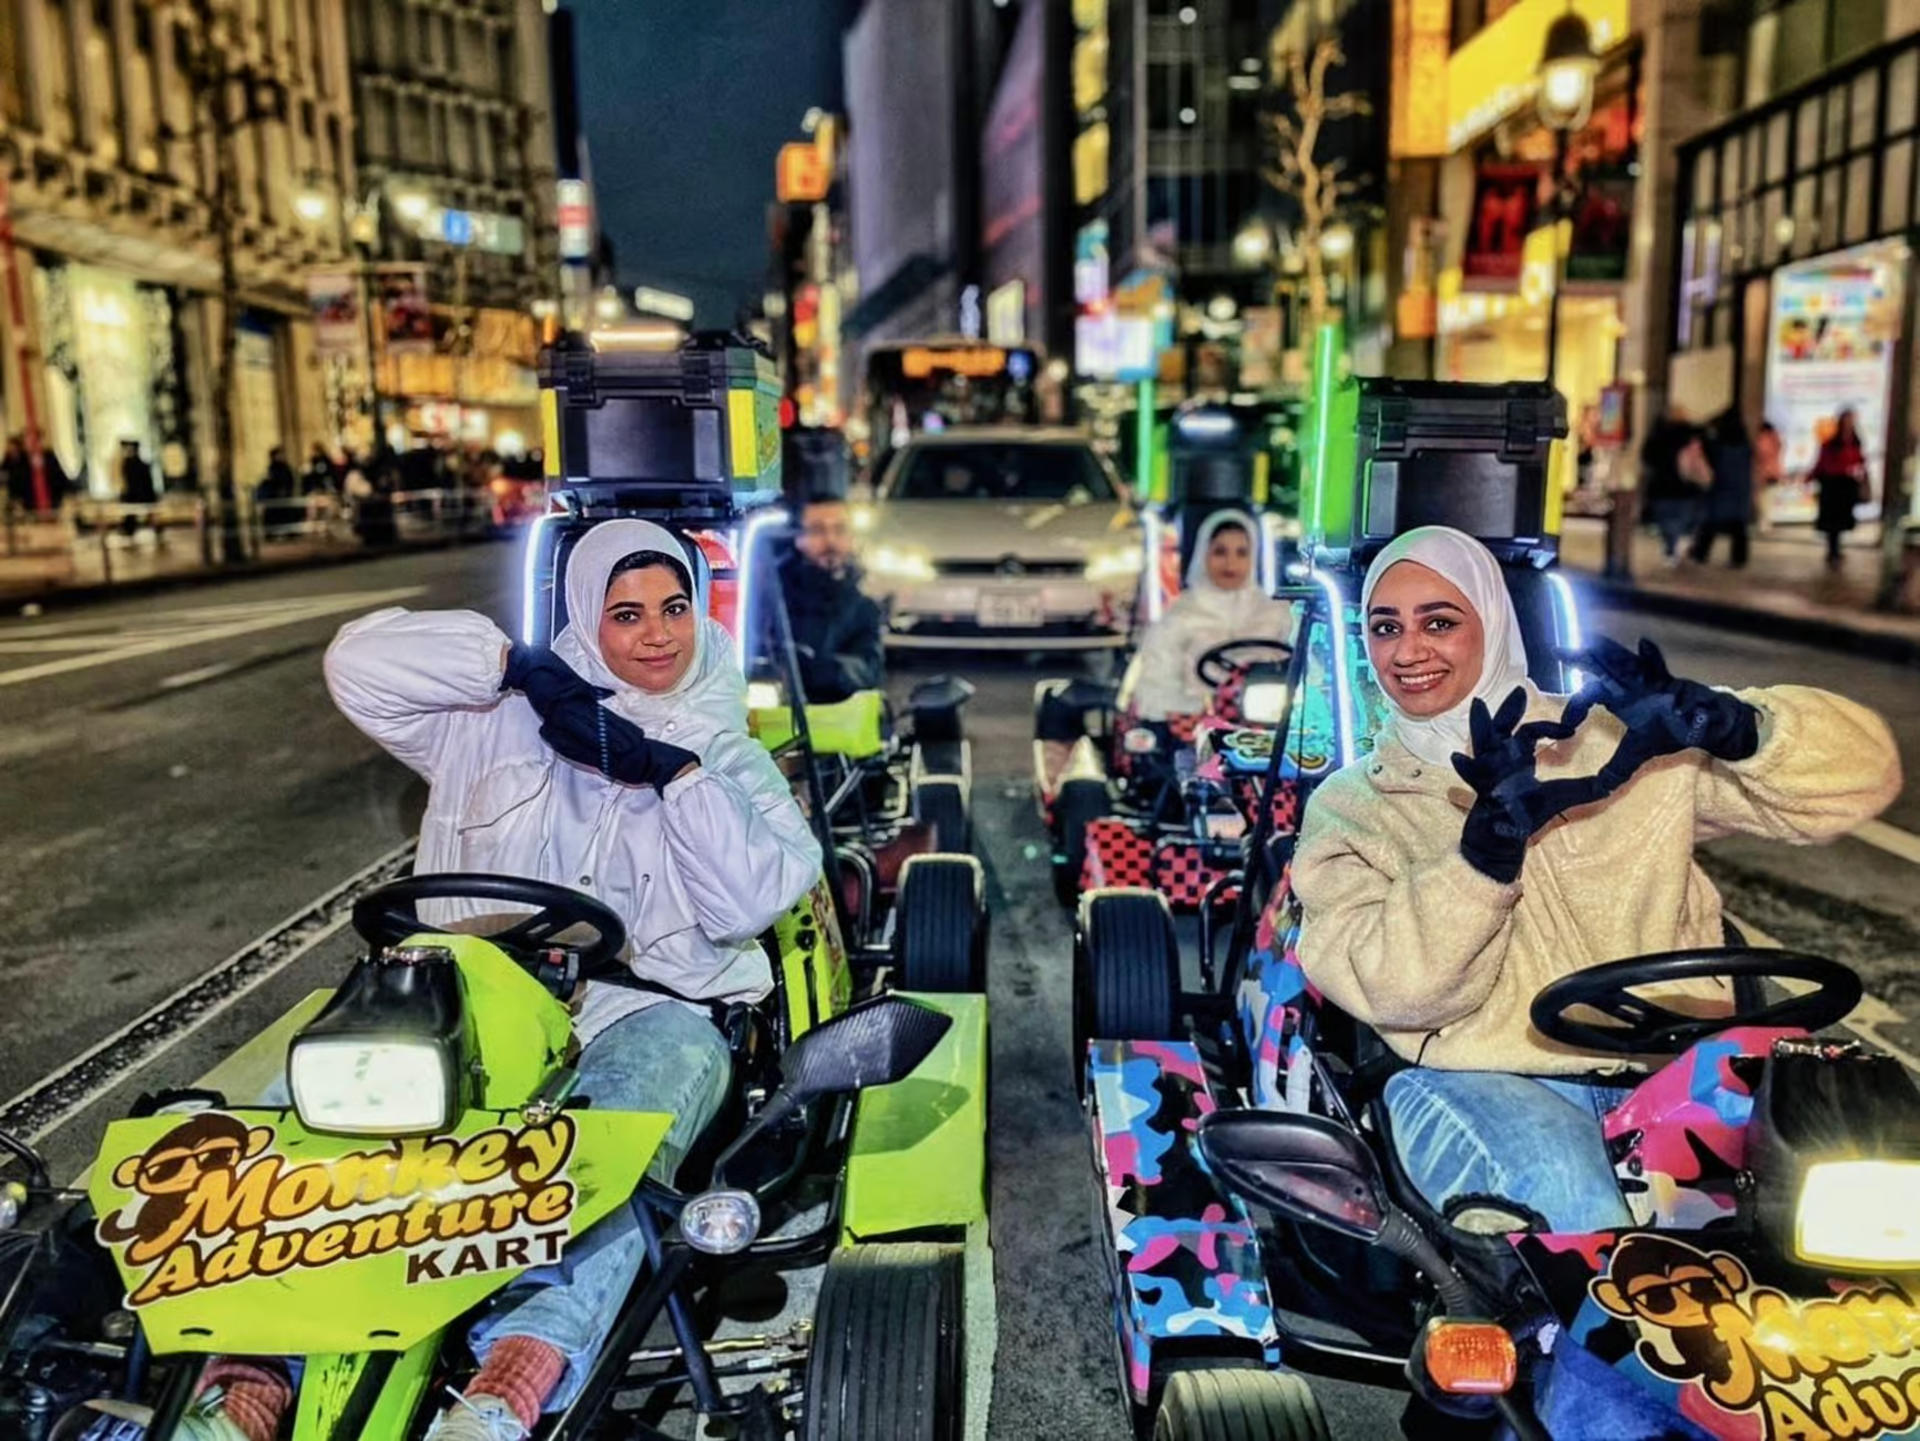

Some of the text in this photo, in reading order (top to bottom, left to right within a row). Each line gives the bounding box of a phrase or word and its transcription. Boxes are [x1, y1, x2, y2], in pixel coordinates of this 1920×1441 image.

[124, 1181, 574, 1308] Adventure
[125, 1114, 576, 1267] Monkey
[406, 1230, 568, 1285] KART
